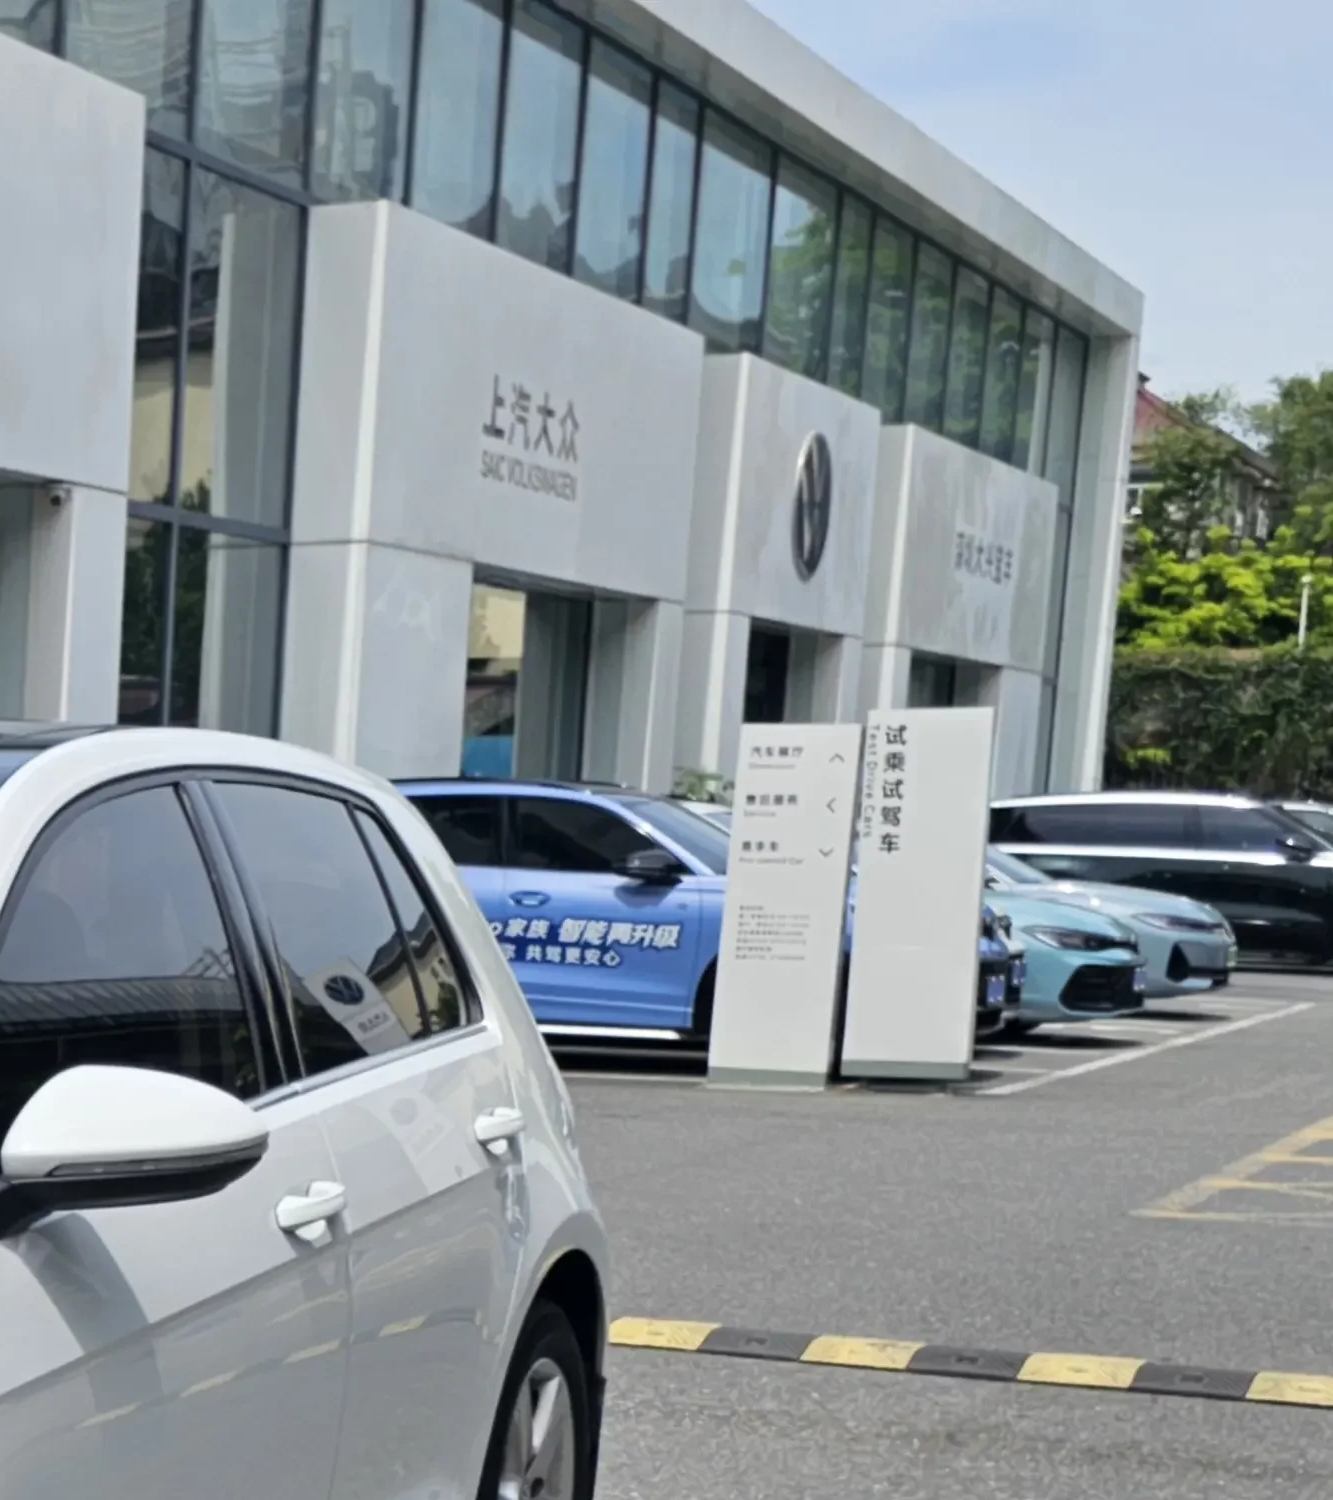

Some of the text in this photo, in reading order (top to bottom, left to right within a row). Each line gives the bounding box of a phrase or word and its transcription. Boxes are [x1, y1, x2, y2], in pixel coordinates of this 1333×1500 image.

[481, 373, 580, 464] 上汽大众
[878, 724, 908, 854] 试乘试驾车
